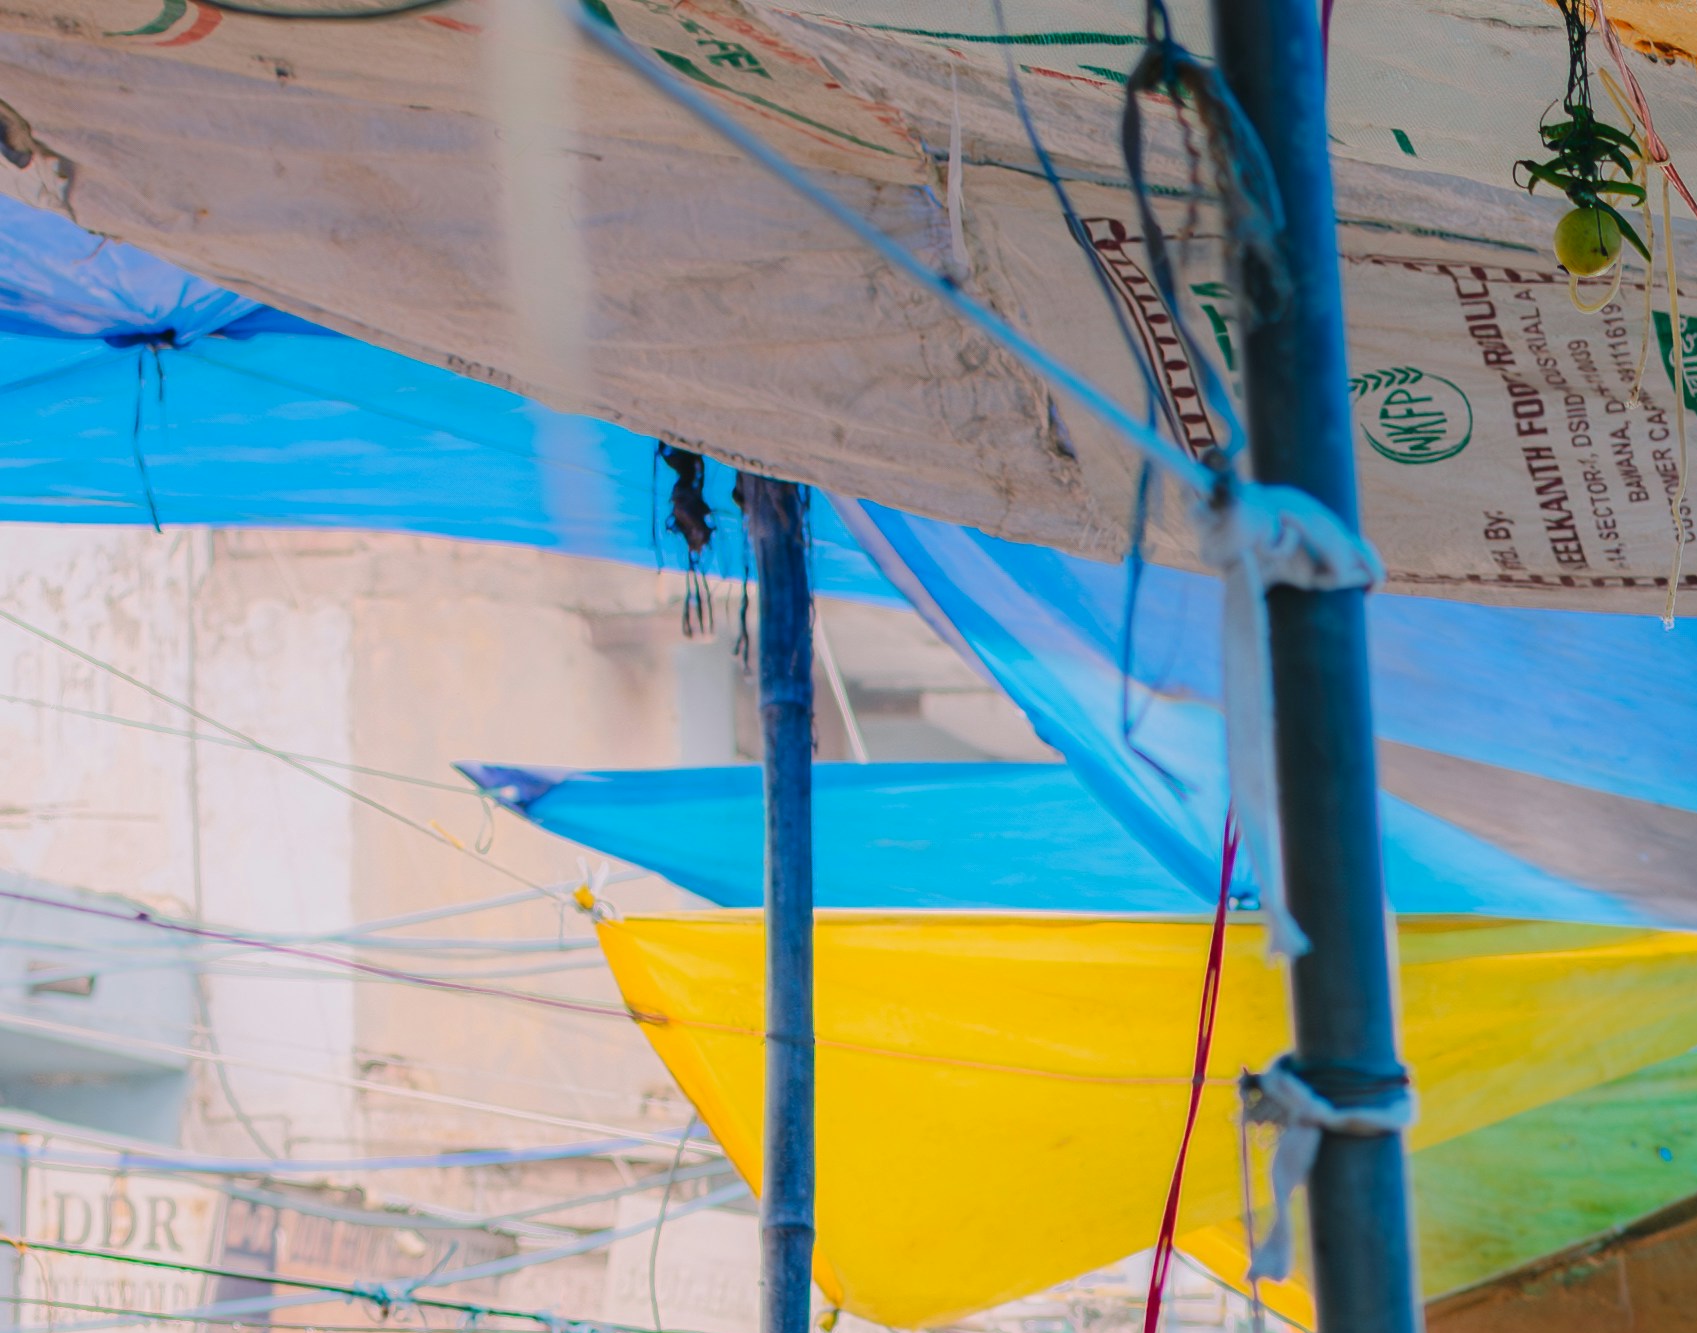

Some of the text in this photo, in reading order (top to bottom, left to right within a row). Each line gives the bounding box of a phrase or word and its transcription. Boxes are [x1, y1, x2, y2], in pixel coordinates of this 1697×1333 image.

[1379, 388, 1448, 451] NKFP
[1610, 420, 1650, 504] BAWANA,
[1483, 510, 1515, 540] By:
[1521, 446, 1590, 571] EELKANTH
[53, 1190, 184, 1253] DDR
